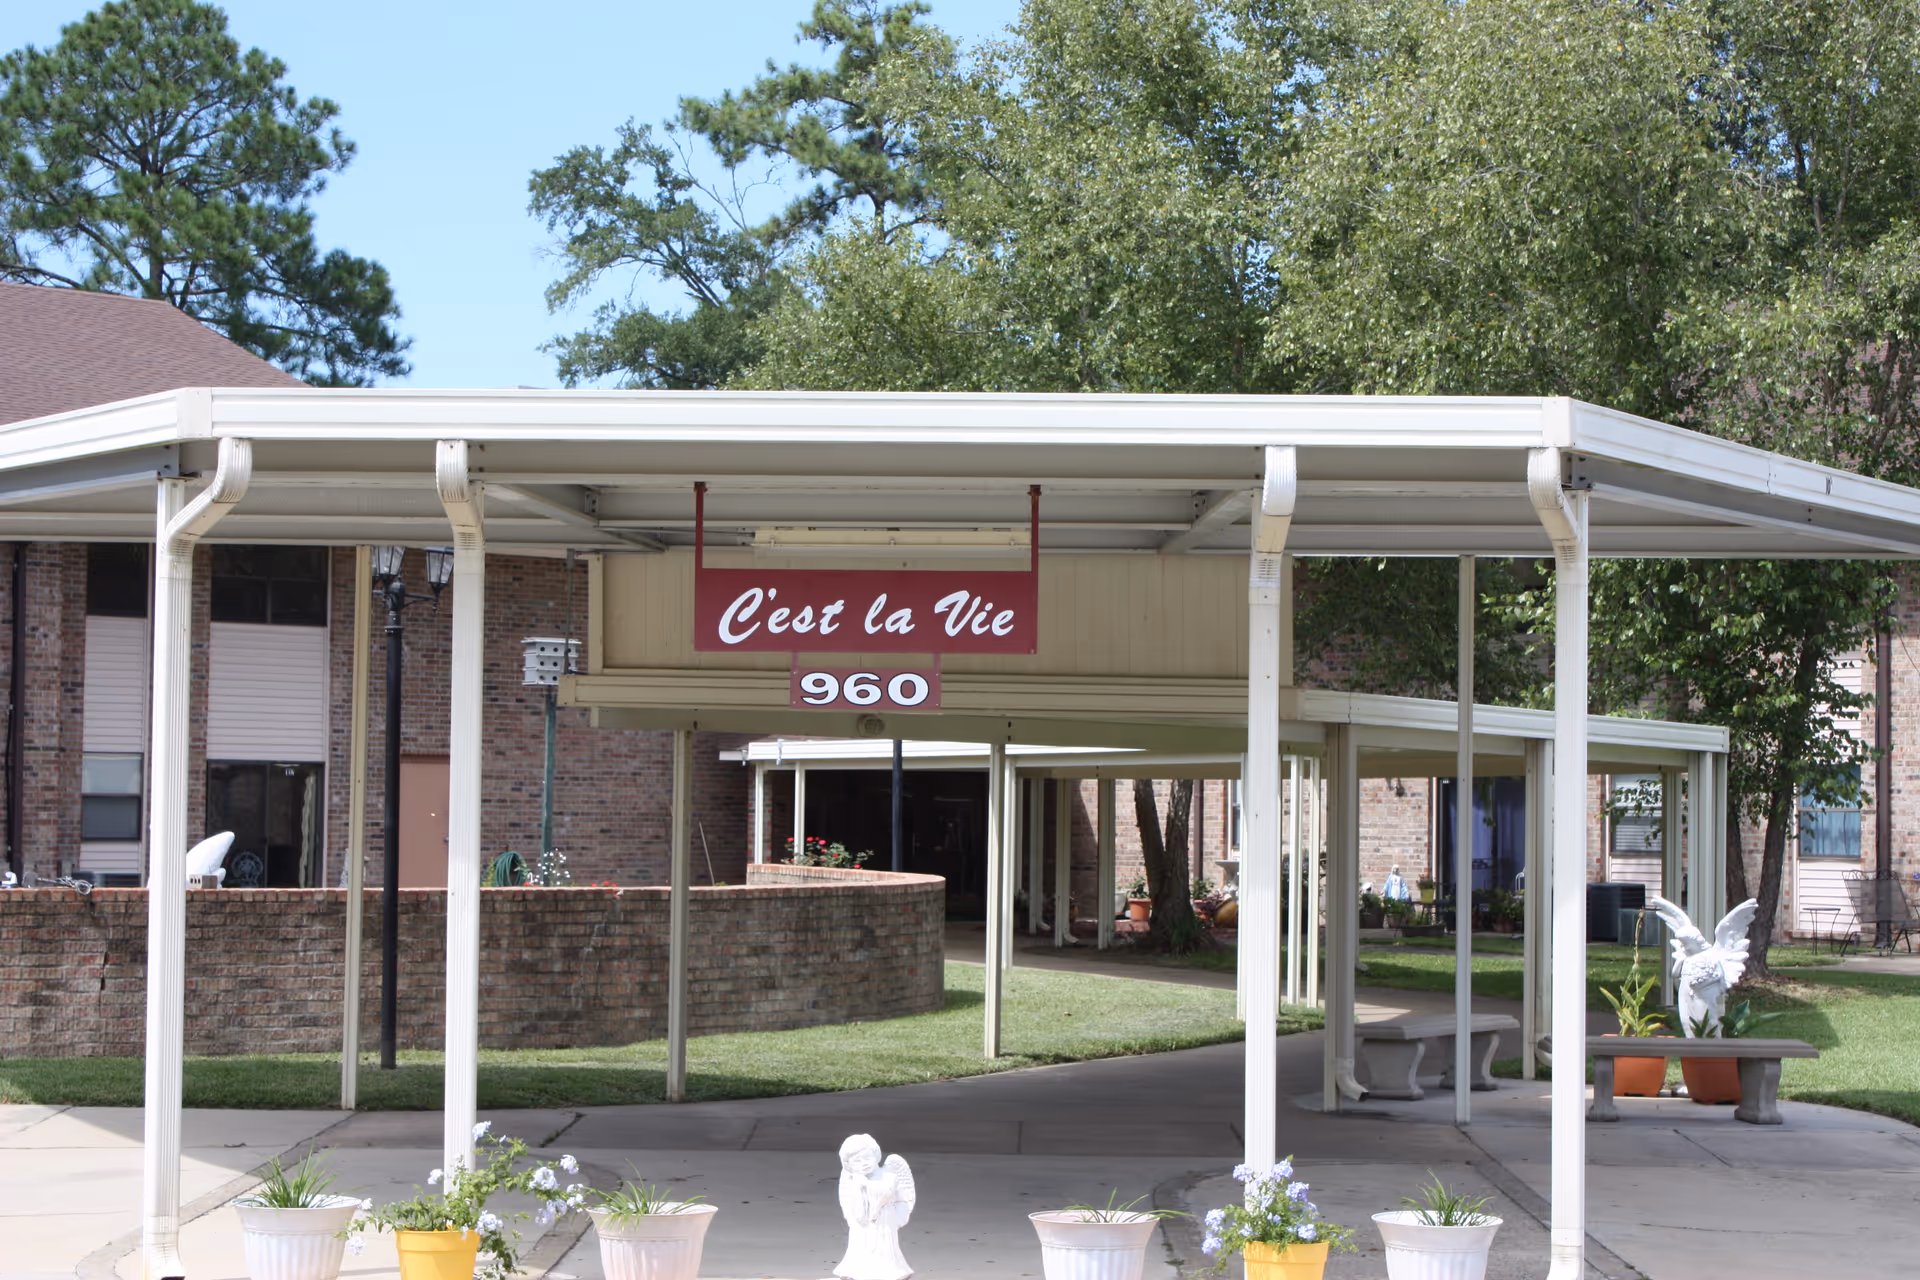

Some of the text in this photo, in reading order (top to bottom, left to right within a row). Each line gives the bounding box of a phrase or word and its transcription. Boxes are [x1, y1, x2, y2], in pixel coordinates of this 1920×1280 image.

[718, 587, 1015, 645] C'est la Vie
[799, 671, 930, 707] 960
